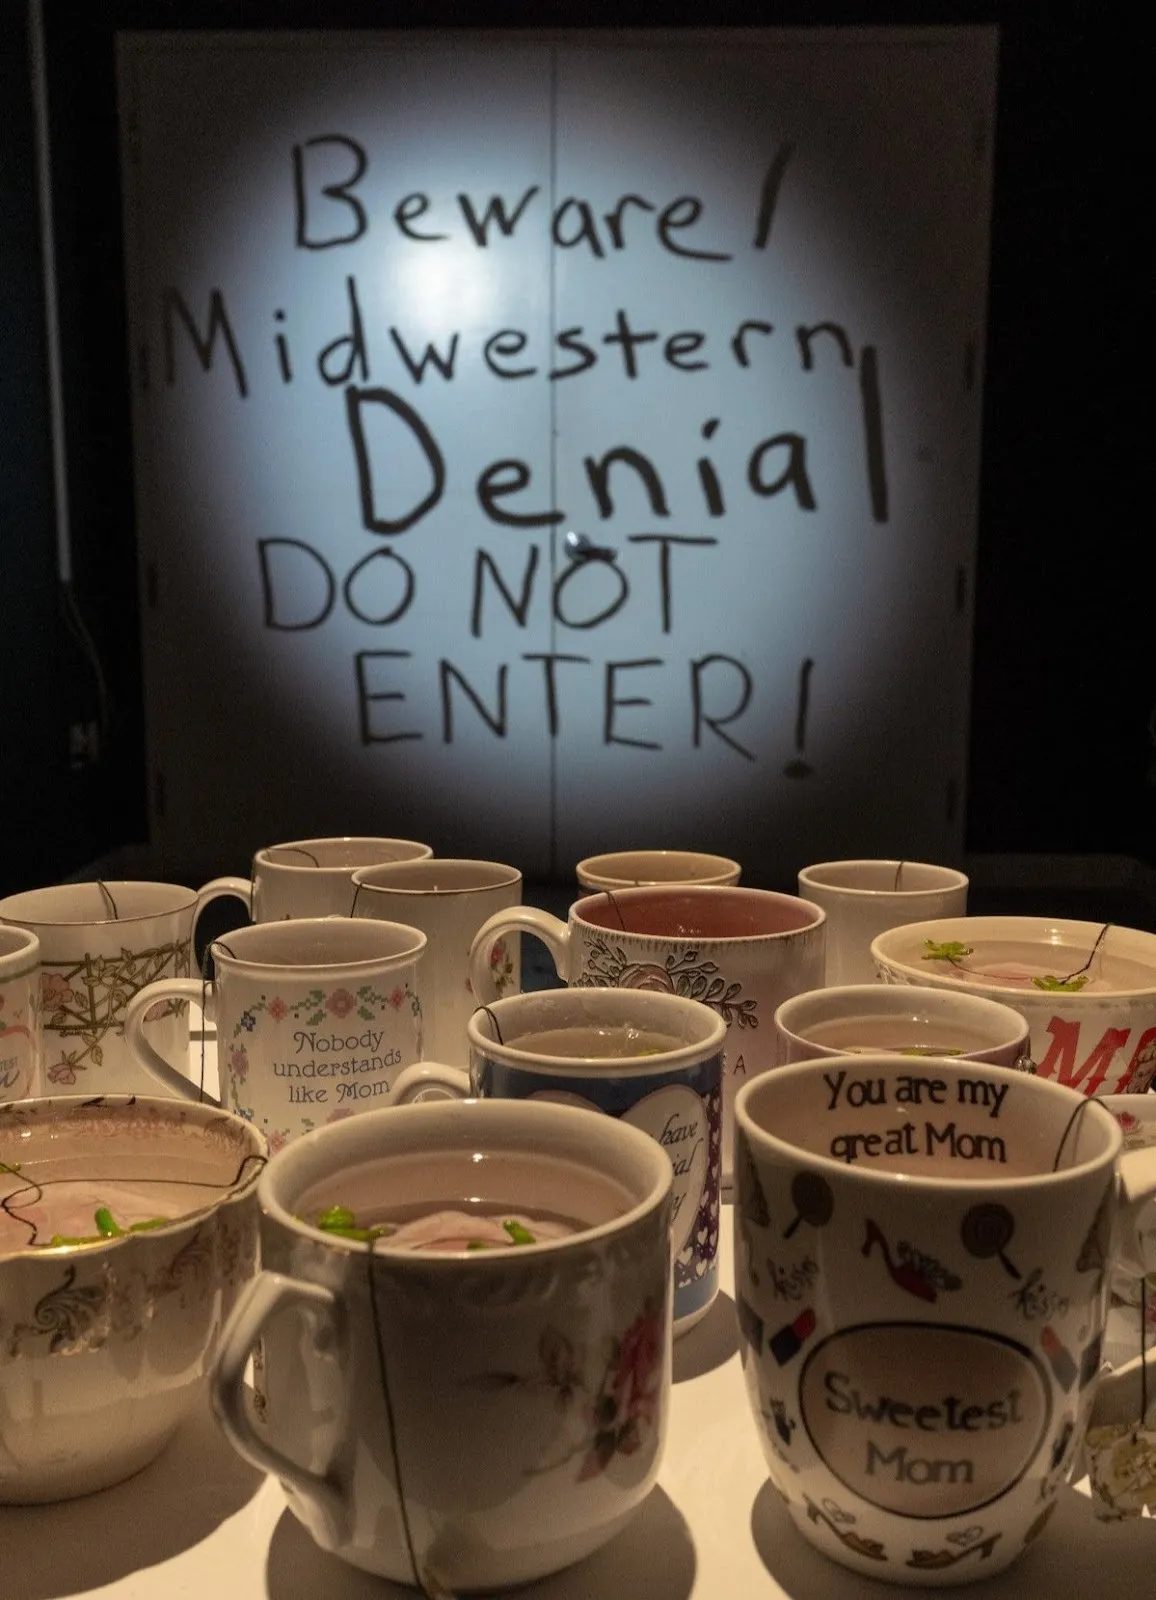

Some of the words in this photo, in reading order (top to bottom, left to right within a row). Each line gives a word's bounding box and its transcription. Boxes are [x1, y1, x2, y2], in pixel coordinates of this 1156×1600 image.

[165, 273, 855, 399] Midwestern
[346, 344, 890, 536] Denial
[258, 537, 417, 632] DO
[471, 530, 718, 638] NOT
[355, 649, 814, 780] ENTER!
[273, 1048, 402, 1078] understands
[293, 1029, 385, 1054] Nobody
[289, 1085, 329, 1103] like
[336, 1079, 391, 1103] Mom
[823, 1071, 887, 1110] You
[895, 1076, 947, 1104] are
[957, 1079, 1009, 1118] my
[830, 1122, 919, 1163] great
[925, 1122, 1007, 1163] Mom
[823, 1371, 1023, 1431] Sweetest
[865, 1440, 974, 1486] Mom
